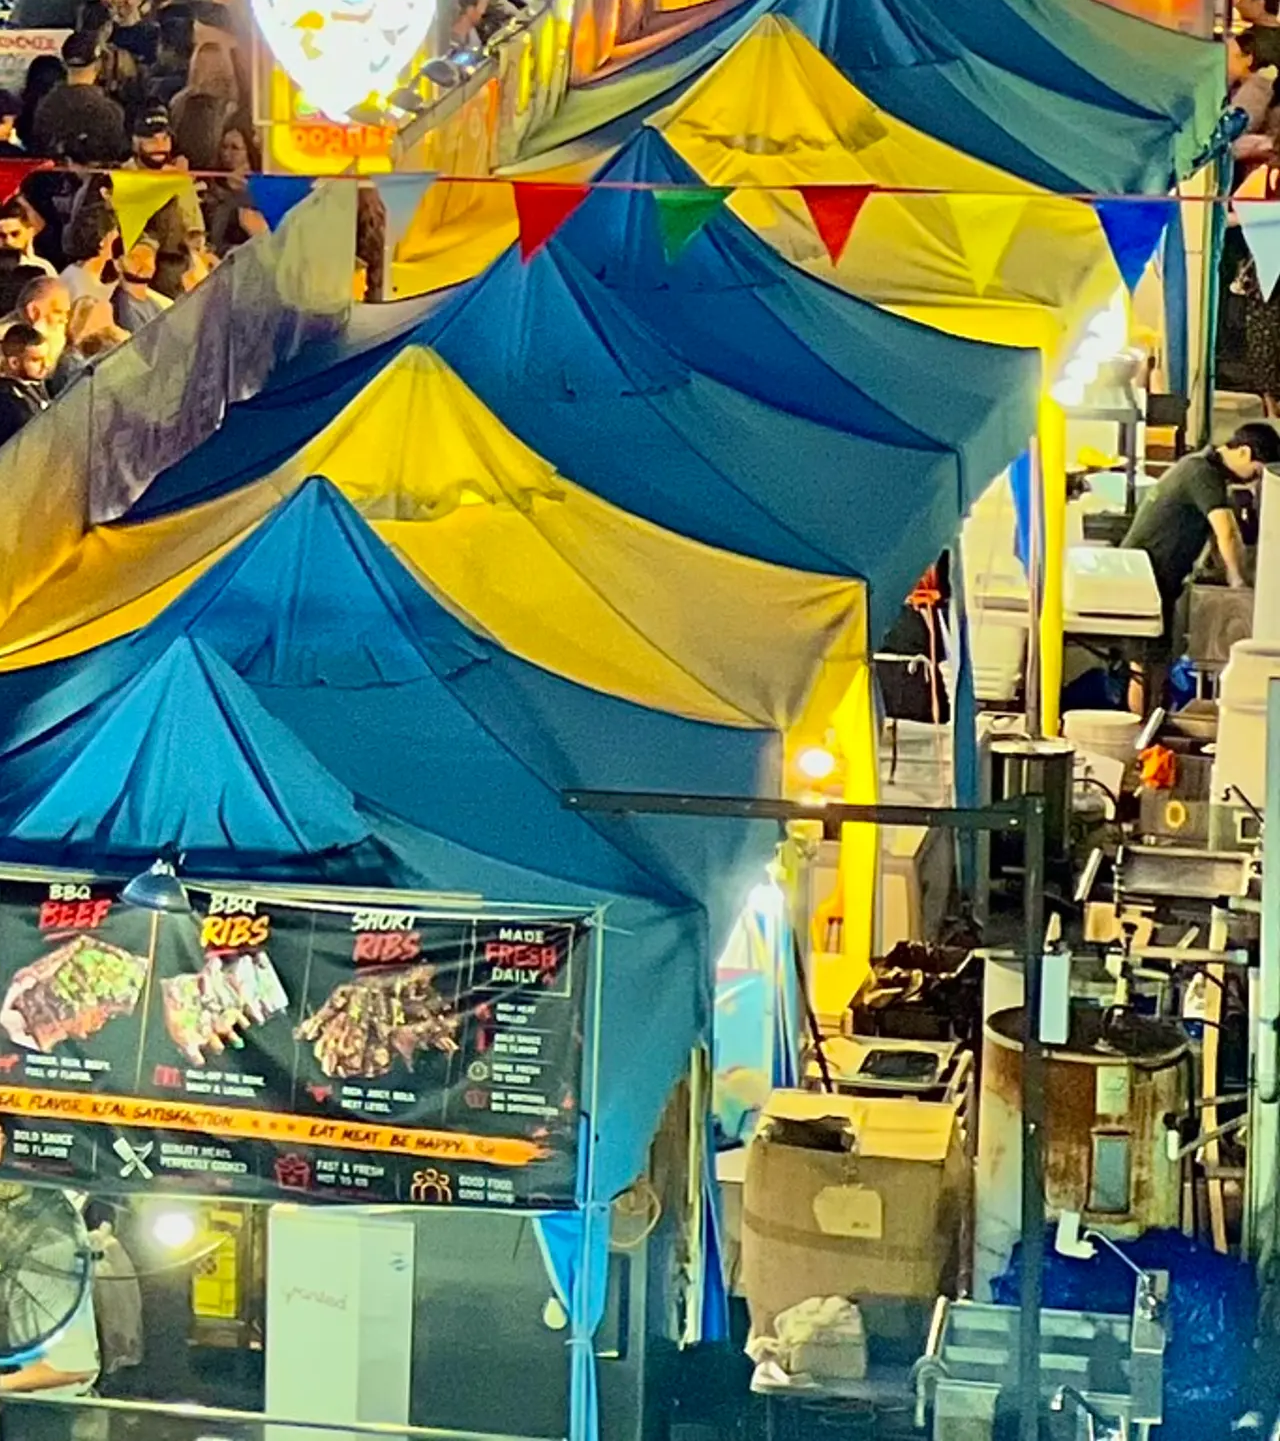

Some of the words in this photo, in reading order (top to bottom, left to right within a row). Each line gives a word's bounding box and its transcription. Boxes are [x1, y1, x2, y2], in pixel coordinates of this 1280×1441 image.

[49, 884, 91, 900] BBQ
[40, 900, 112, 928] BEEF
[208, 893, 258, 915] BBQ
[201, 915, 270, 946] RIBS
[500, 928, 544, 943] MADE
[354, 932, 423, 960] RIBS
[485, 943, 557, 966] FRESH
[492, 967, 539, 983] DAILY
[91, 1101, 127, 1118] REAL
[308, 1124, 338, 1139] EAT
[341, 1128, 383, 1145] MEAT.
[389, 1135, 408, 1147] BE
